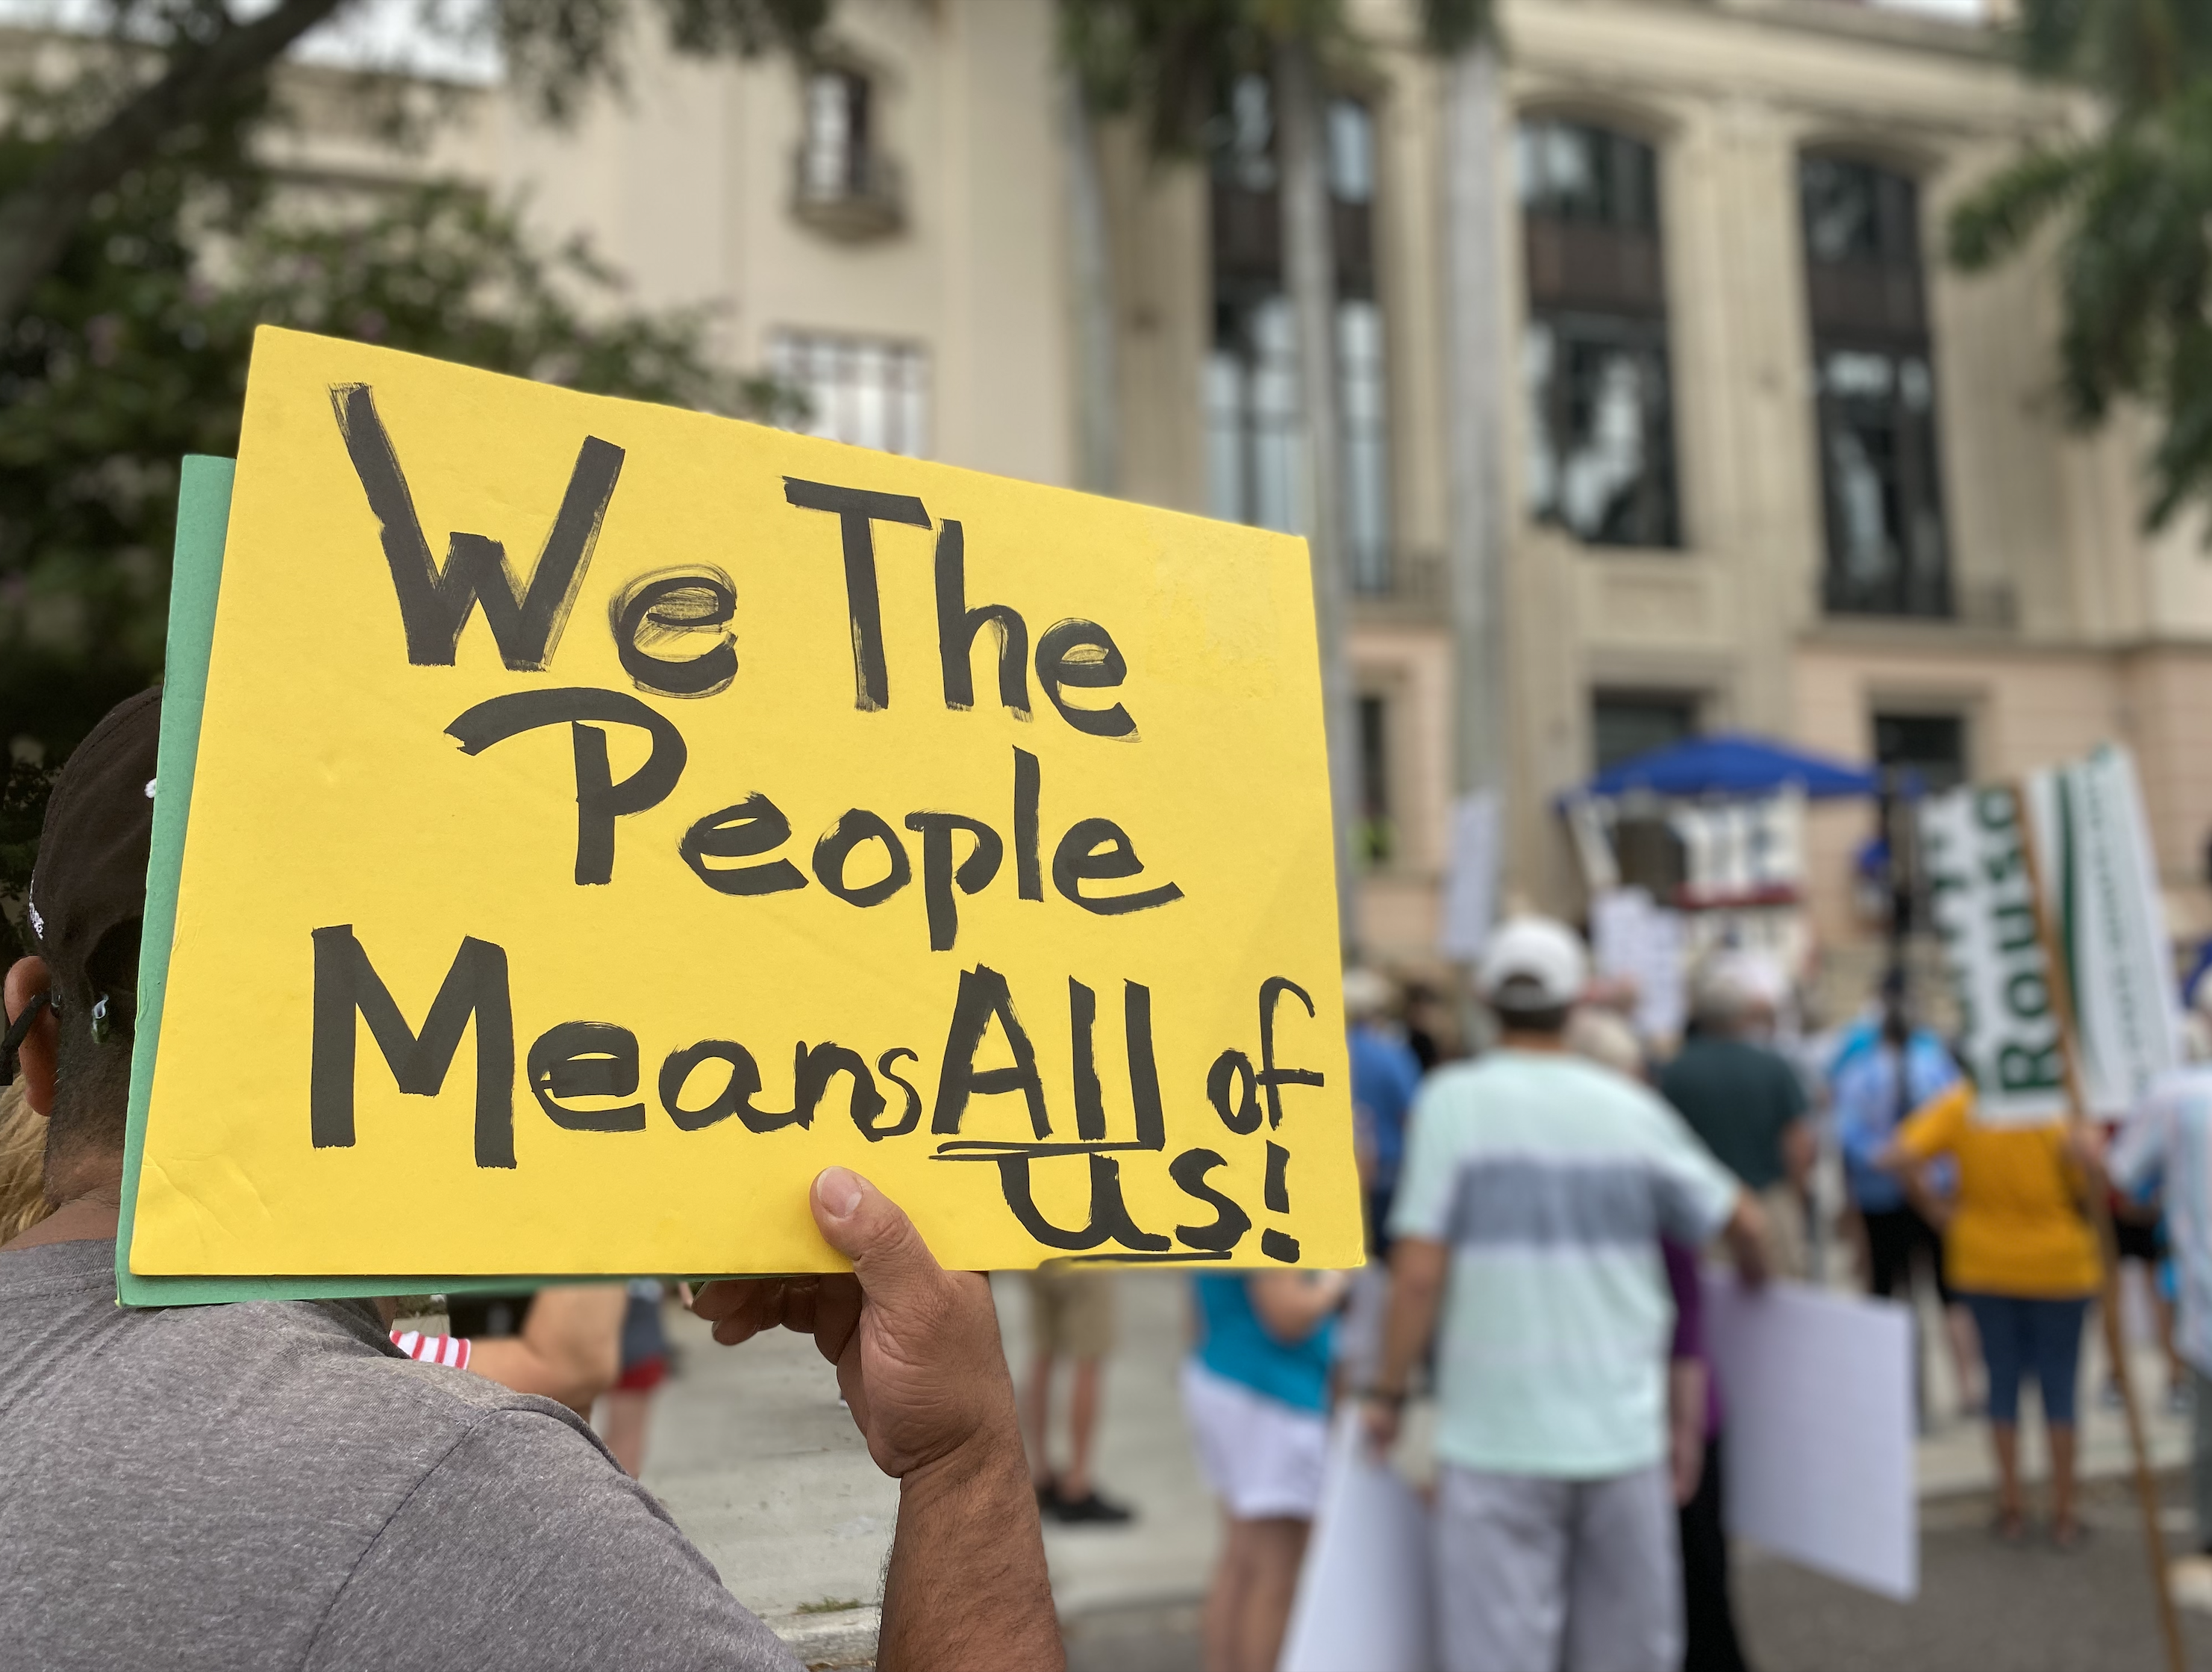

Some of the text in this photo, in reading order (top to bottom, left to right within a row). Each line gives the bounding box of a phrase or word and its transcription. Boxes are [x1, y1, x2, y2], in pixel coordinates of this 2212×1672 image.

[325, 381, 1142, 743] We The
[443, 687, 1185, 952] People
[310, 924, 1324, 1169] Means All of
[998, 1139, 1300, 1263] us!
